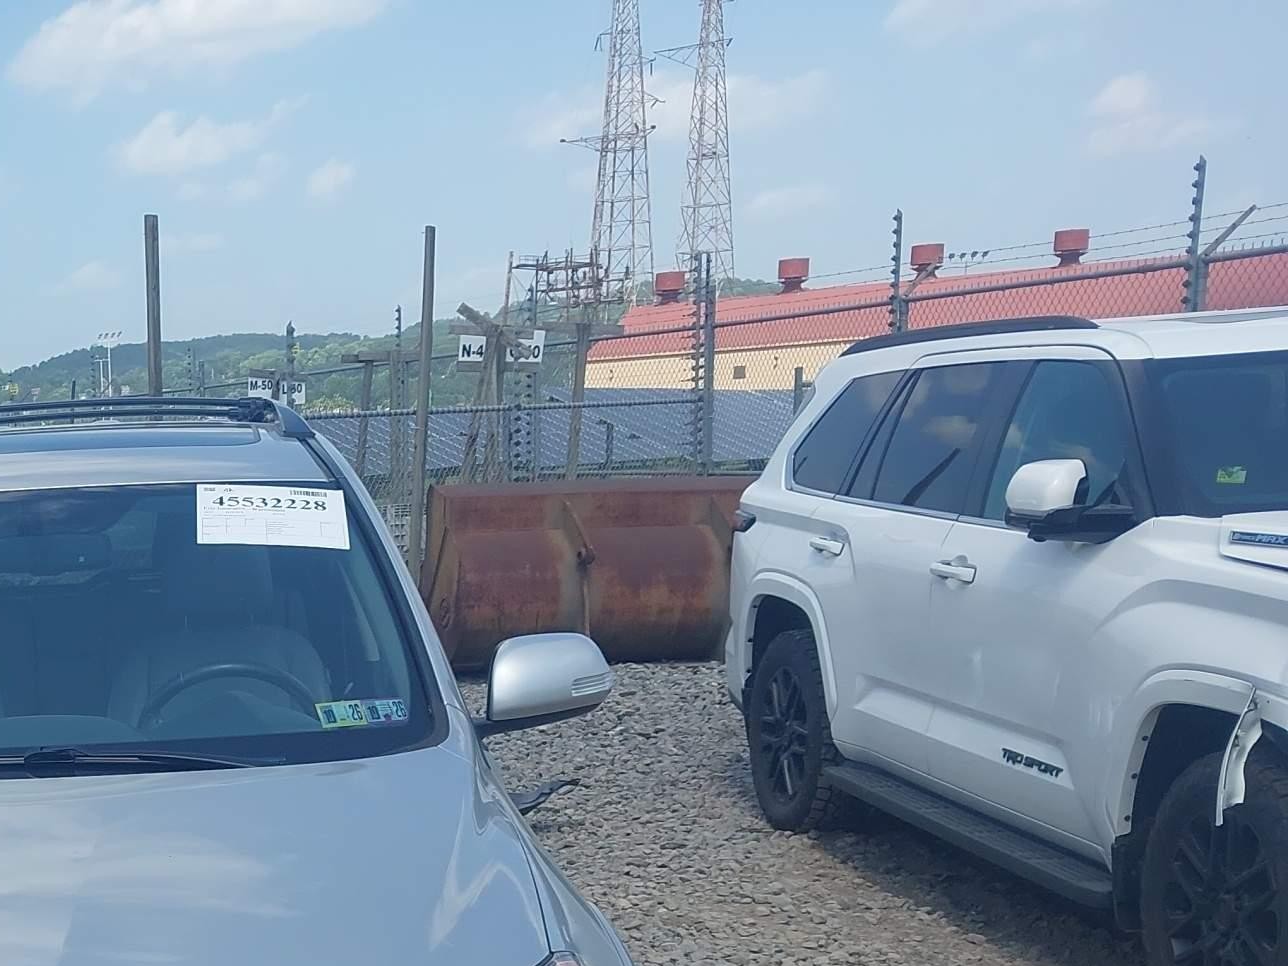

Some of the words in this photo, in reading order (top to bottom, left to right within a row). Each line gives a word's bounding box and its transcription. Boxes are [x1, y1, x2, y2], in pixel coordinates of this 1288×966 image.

[249, 380, 273, 391] M-50
[212, 496, 327, 511] 45532228
[1001, 747, 1024, 766] TRD
[1022, 755, 1064, 778] SPORT
